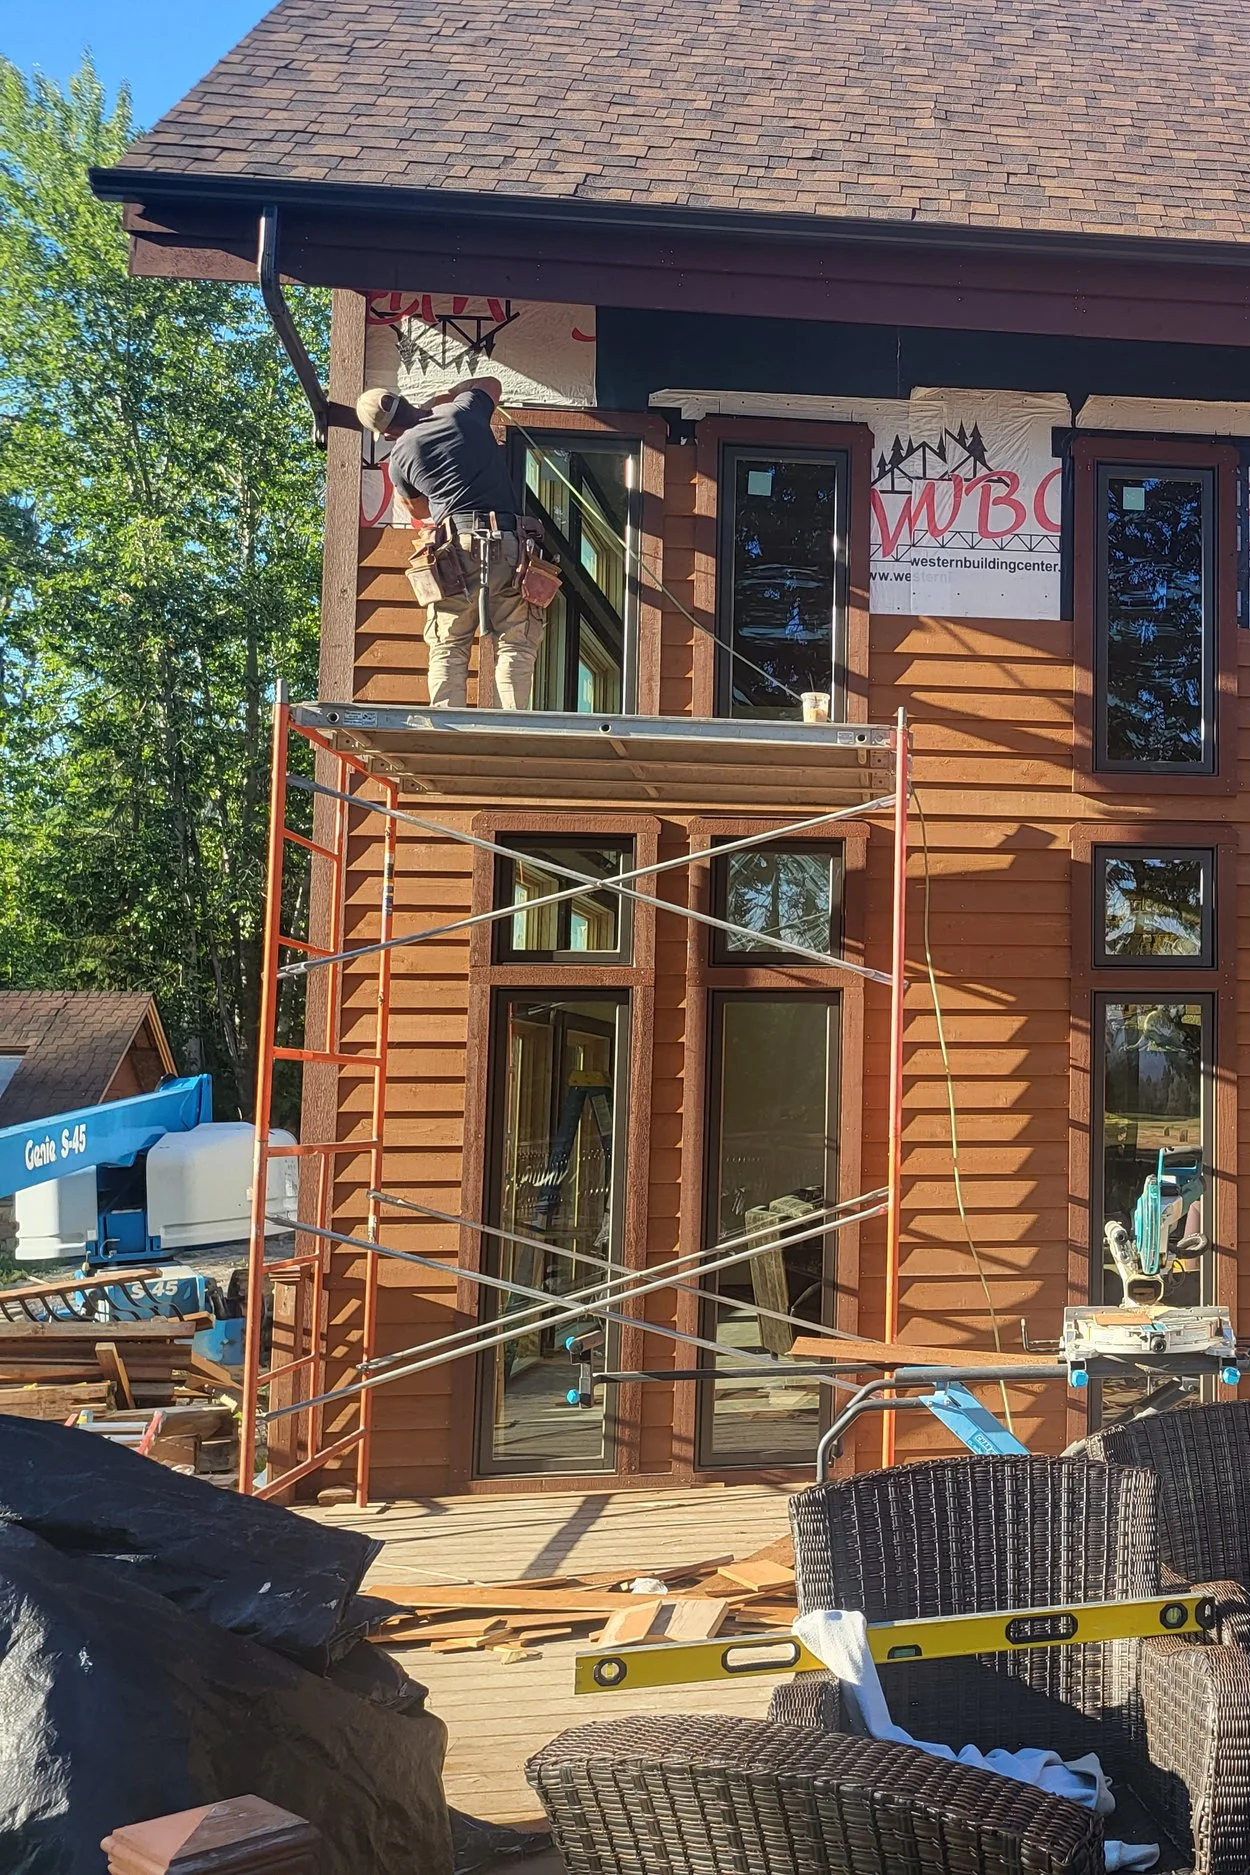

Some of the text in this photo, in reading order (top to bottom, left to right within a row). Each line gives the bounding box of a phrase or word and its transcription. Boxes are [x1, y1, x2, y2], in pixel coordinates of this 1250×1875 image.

[25, 1123, 87, 1171] Genie S-45
[130, 1281, 178, 1299] S45
